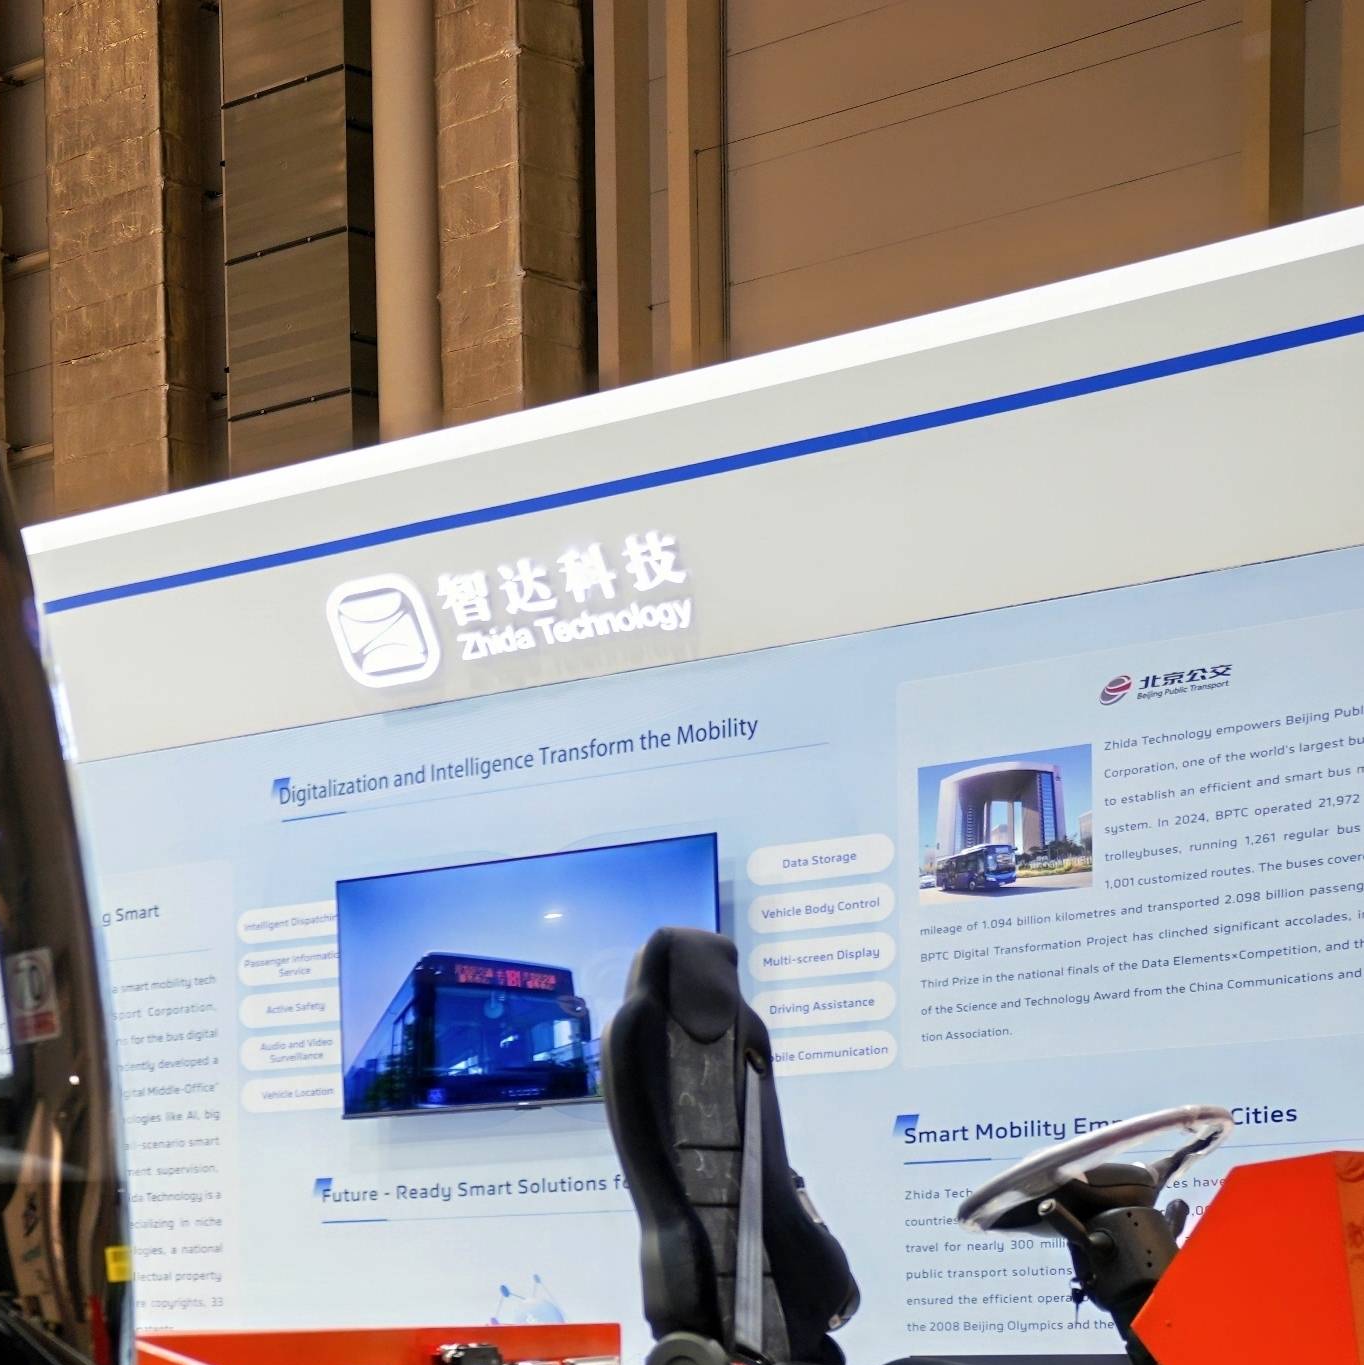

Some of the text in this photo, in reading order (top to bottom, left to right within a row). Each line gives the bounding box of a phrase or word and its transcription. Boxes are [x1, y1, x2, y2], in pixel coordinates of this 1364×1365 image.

[439, 530, 687, 626] 智达科技
[458, 595, 692, 662] Zhida Technology
[1139, 664, 1232, 690] 北京公交
[1164, 680, 1230, 696] Public Transport
[1105, 712, 1329, 751] Zhida Technology empowers Beijing
[277, 717, 758, 807] Digitalization and Intelligence Transform the Mobility
[1104, 738, 1344, 779] Corporation, one of the world's largest
[1105, 767, 1351, 807] to establish an efficient and smart bus
[1105, 793, 1360, 836] system. In 2024, BPTC operated 21,972
[1105, 824, 1360, 862] trolleybuses, running 1,261 regular bus
[783, 853, 856, 869] Data Storage
[1105, 858, 1324, 890] 1,001 customized routes. The buses
[116, 905, 159, 922] Smart
[761, 896, 879, 920] Vehicle Body Control
[920, 888, 1304, 936] mileage of 1.094 billion kilometres and transported 2.098 billion
[921, 912, 1351, 963] BPTC Digital Transformation Project has clinched significant accolades,
[244, 954, 290, 968] Passenger
[763, 948, 879, 967] Multi-screen Display
[920, 977, 948, 989] Third
[952, 977, 979, 985] Prize
[983, 974, 992, 983] in
[996, 972, 1014, 983] the
[1018, 967, 1063, 981] national
[1068, 964, 1099, 976] finals
[1103, 962, 1115, 973] of
[1119, 961, 1138, 971] the
[1142, 958, 1169, 969] Data
[1325, 940, 1349, 952] and
[278, 966, 311, 977] Service
[921, 968, 1361, 1015] of the Science and Technology Award from the China Communications and
[266, 1001, 325, 1014] Active Safety
[770, 998, 875, 1015] Driving Assistance
[921, 1027, 1012, 1042] tion Association.
[270, 1052, 324, 1063] Surveillance
[798, 1045, 888, 1061] Communication
[262, 1086, 334, 1100] Vehicle Location
[903, 1105, 1297, 1144] Smart Mobility Cities
[320, 1176, 607, 1203] Future Ready Smart Solutions
[905, 1189, 940, 1201] Zhida
[906, 1239, 1034, 1253] travel for nearly 300
[906, 1265, 1073, 1281] public transport solutions
[907, 1293, 1032, 1306] ensured efficient
[930, 1320, 1063, 1333] 2008 Beijing Olympics
